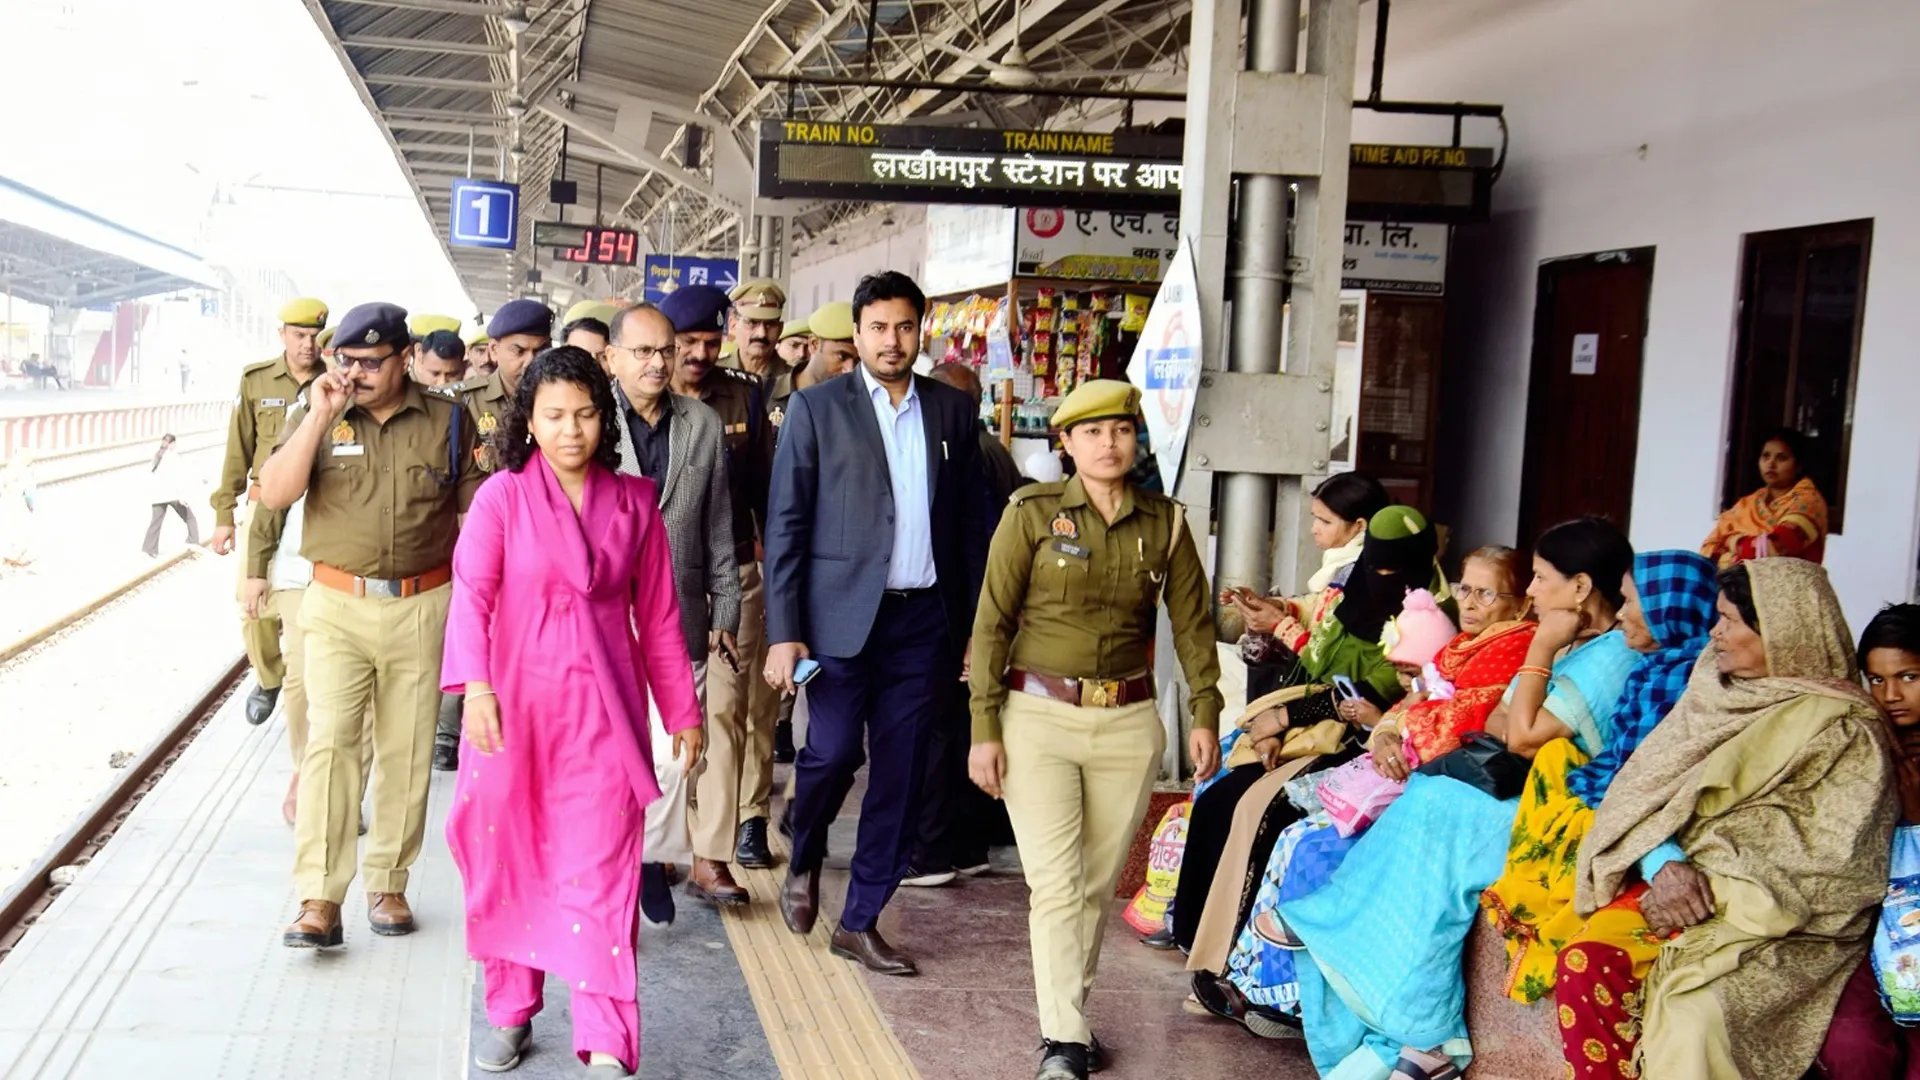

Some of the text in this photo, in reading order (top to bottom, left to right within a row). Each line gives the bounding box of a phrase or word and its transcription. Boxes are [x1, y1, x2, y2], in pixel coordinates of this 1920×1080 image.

[785, 122, 880, 144] TRAIN NO.
[1003, 131, 1115, 153] TRAIN NAME
[1353, 146, 1389, 164] TIME
[870, 149, 995, 188] लखीमपुर
[1000, 153, 1087, 187] स्टेशन
[1091, 161, 1130, 188] पर
[471, 194, 491, 235] 1
